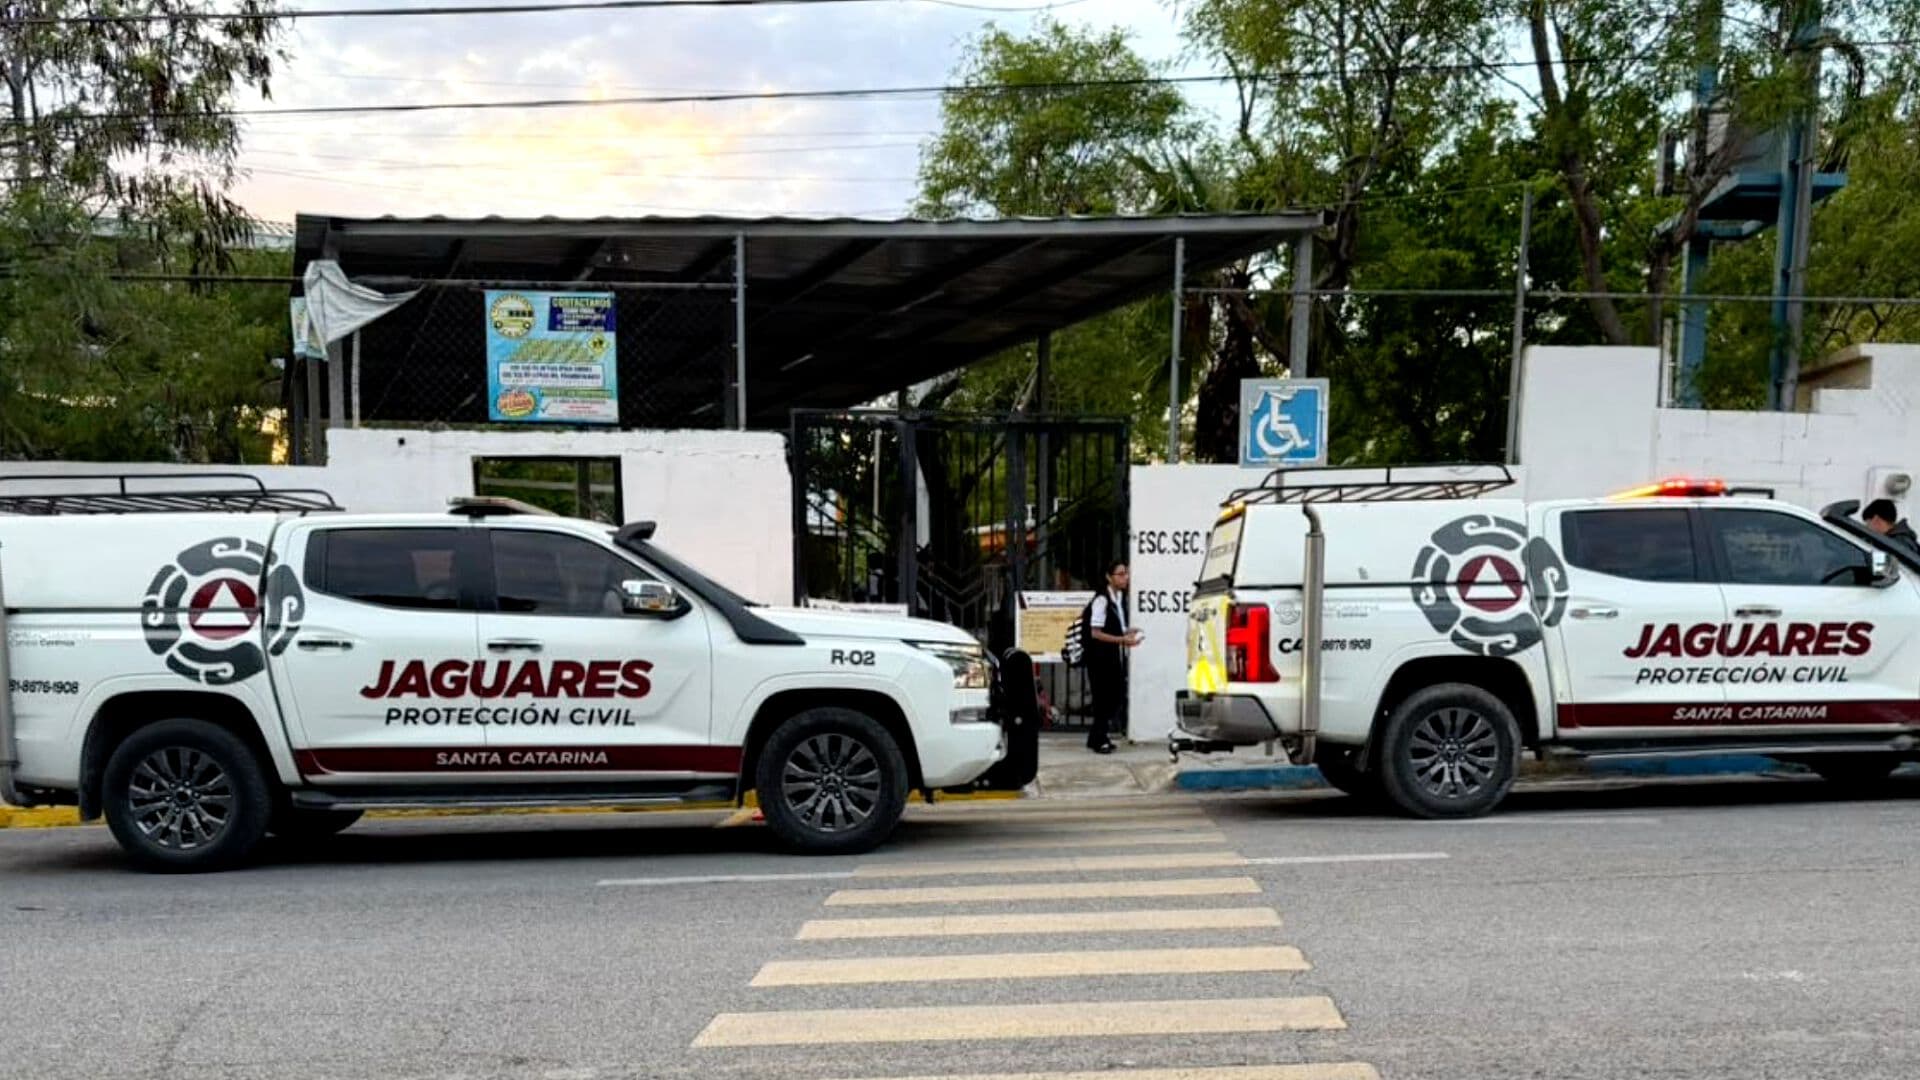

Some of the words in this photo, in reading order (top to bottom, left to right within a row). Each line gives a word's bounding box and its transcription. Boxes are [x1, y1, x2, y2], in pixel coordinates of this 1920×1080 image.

[1623, 621, 1875, 658] JAGUARES
[831, 649, 876, 666] R-02
[359, 659, 654, 699] JAGUARES
[1635, 663, 1787, 685] PROTECCIÓN
[1792, 666, 1849, 683] CIVIL
[385, 703, 560, 726] PROTECCIÓN
[569, 708, 636, 727] CIVIL
[1672, 706, 1733, 720] SANTA
[1738, 706, 1828, 720] CATARINA
[436, 751, 502, 766] SANTA
[508, 751, 608, 765] CATARINA
